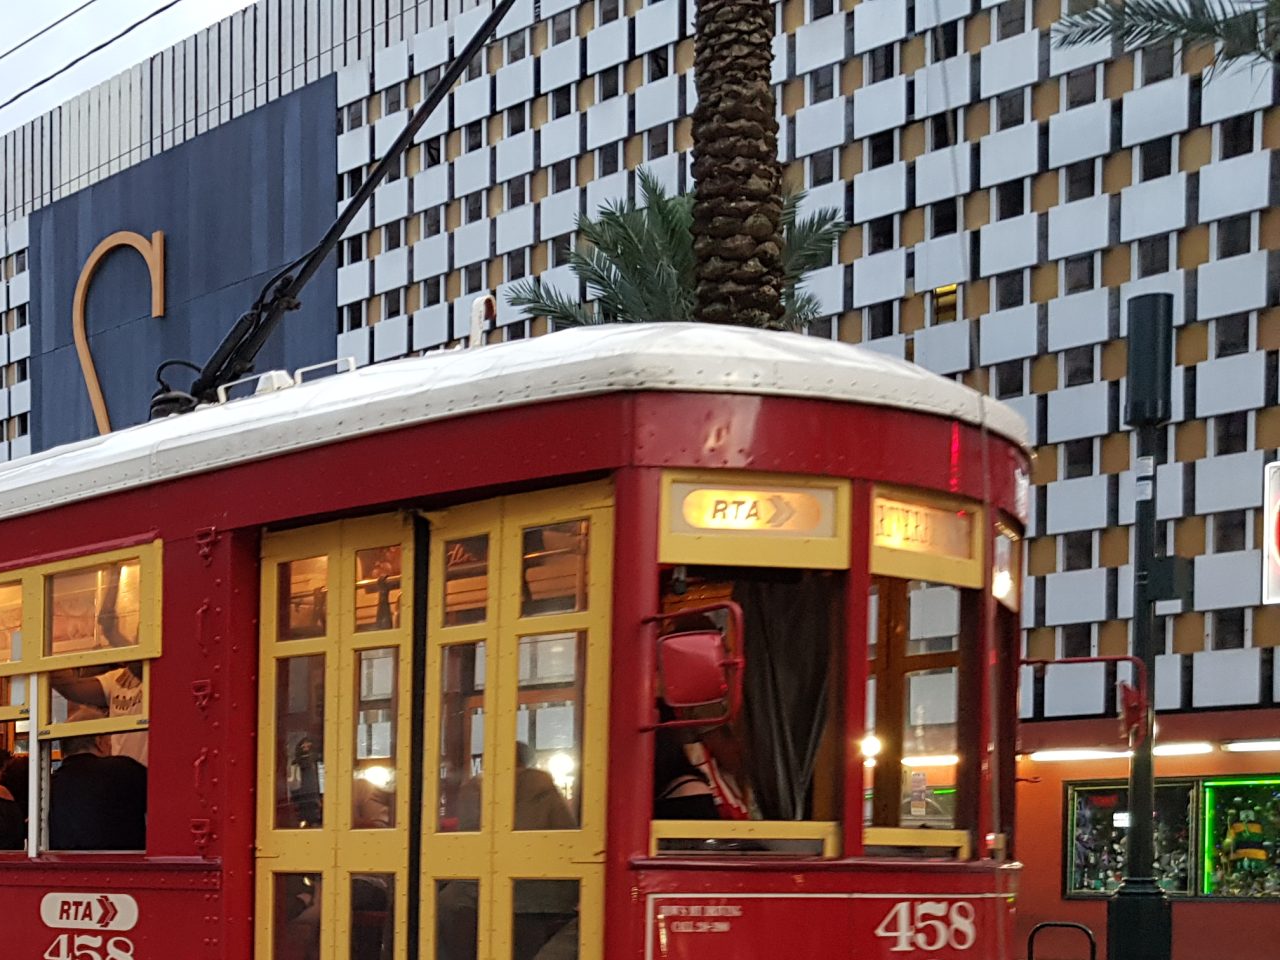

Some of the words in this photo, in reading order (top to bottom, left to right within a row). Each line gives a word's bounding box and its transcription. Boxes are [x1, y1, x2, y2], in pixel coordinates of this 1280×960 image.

[712, 499, 761, 520] RTA
[58, 900, 93, 921] RTA
[873, 901, 977, 952] 458
